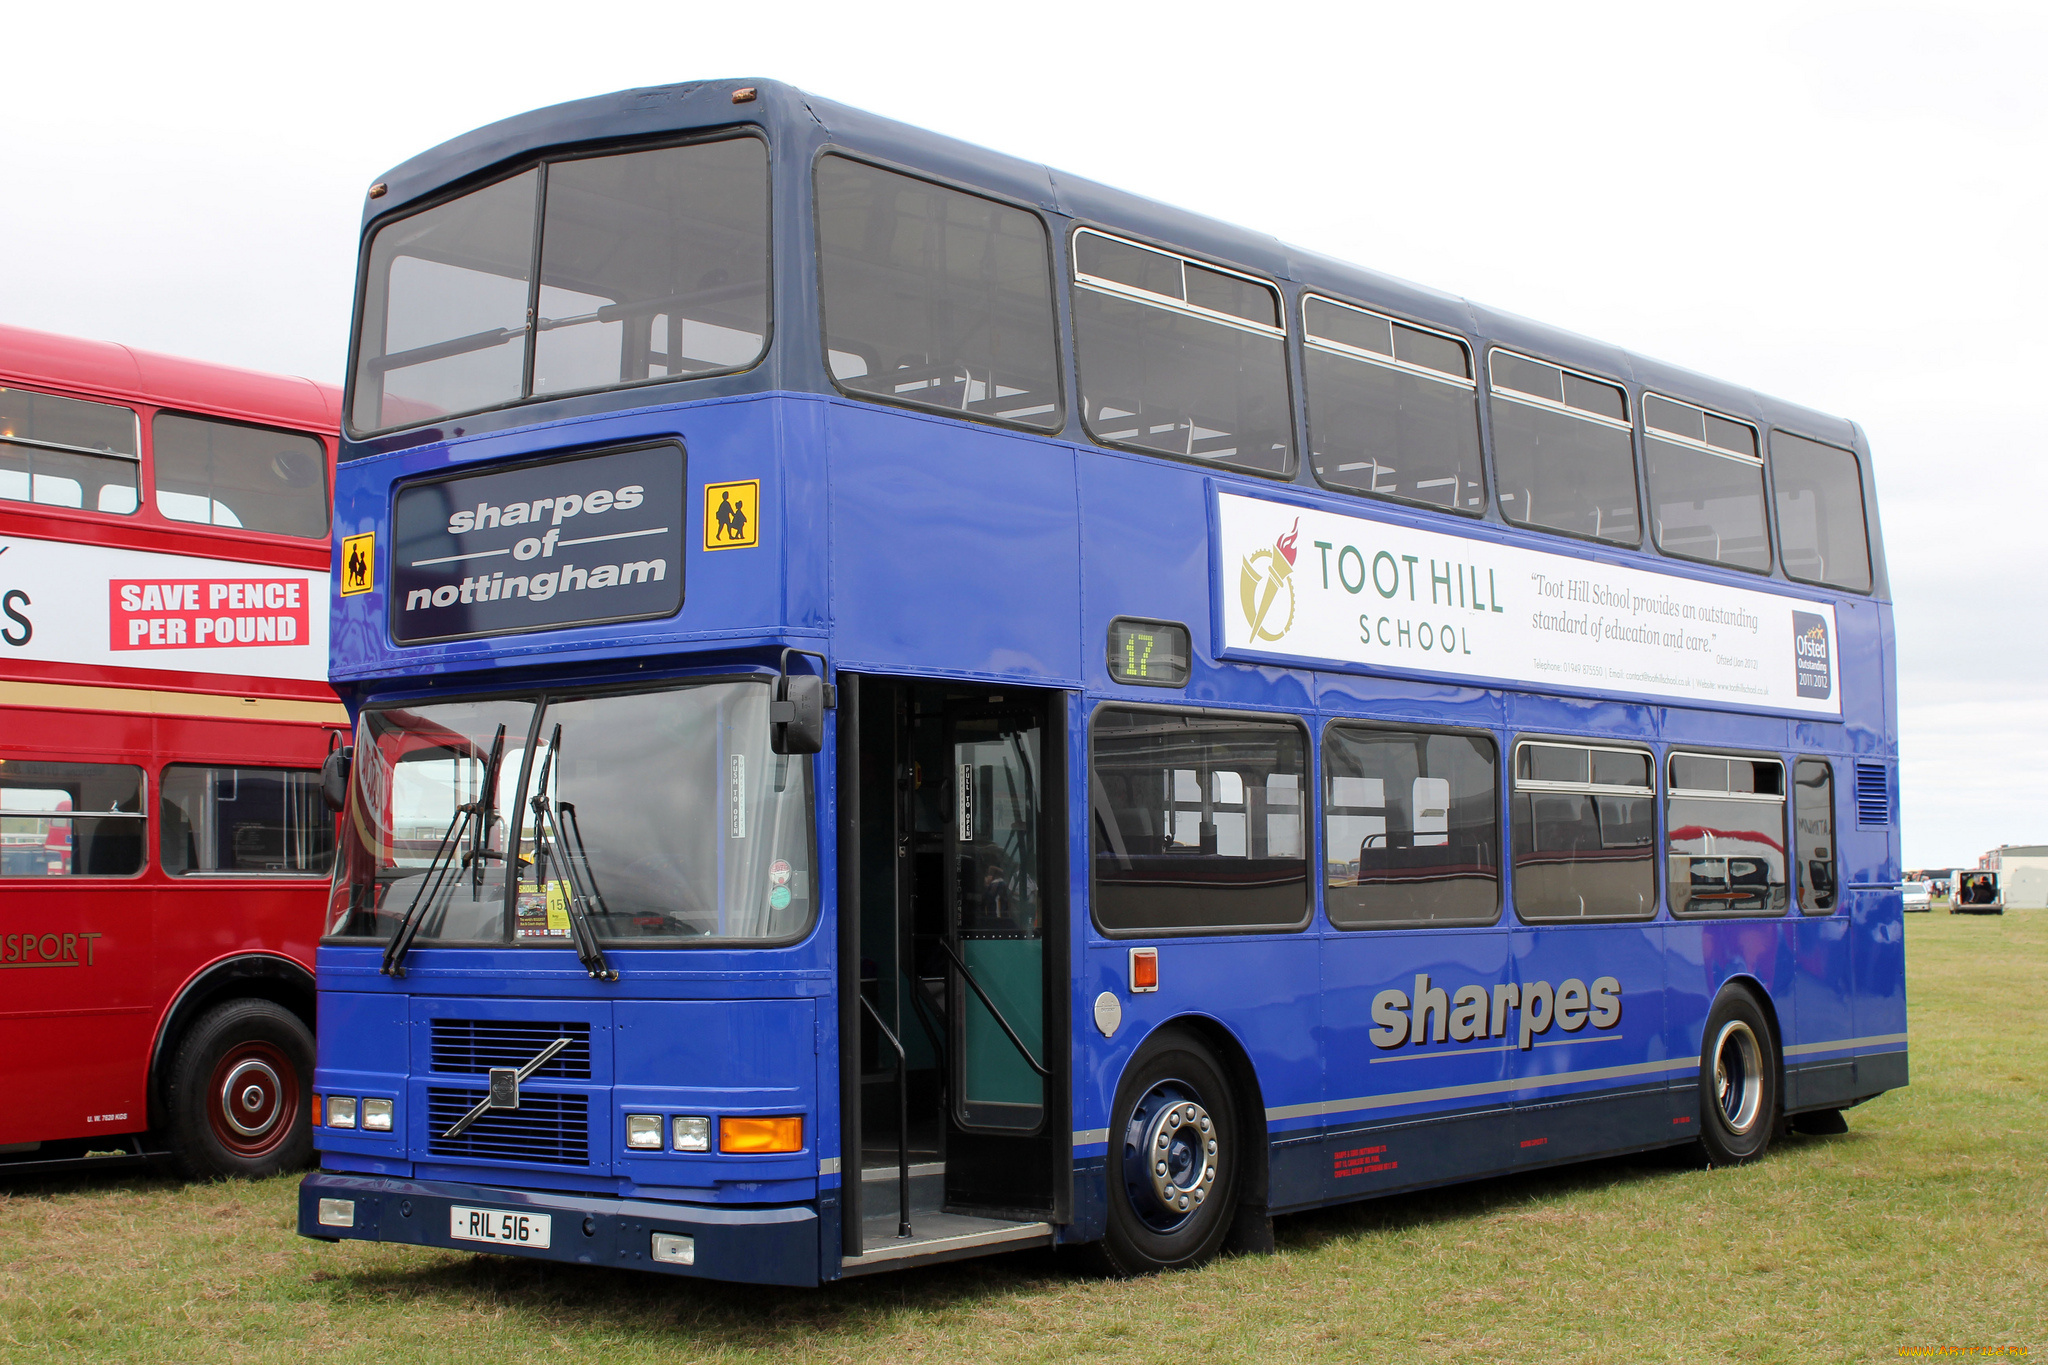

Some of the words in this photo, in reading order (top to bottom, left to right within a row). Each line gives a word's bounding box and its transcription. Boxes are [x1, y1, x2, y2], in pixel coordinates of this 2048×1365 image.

[447, 485, 645, 535] sharpes
[513, 528, 560, 561] of
[405, 558, 667, 612] nottingham
[1314, 540, 1419, 602] TOOT
[1430, 559, 1504, 613] HILL
[120, 584, 200, 612] SAVE
[209, 583, 301, 609] PENCE
[1531, 572, 1564, 599] “Toot
[1567, 579, 1590, 603] Hill
[1592, 584, 1630, 609] School
[1632, 594, 1680, 618] provides
[1682, 604, 1697, 620] an
[1698, 606, 1759, 635] outstanding
[128, 618, 187, 646] PER
[195, 616, 297, 644] POUND
[1359, 614, 1471, 655] SCHOOL
[1532, 610, 1588, 636] standard
[1590, 616, 1604, 643] of
[1605, 618, 1660, 646] education
[1663, 628, 1684, 649] and
[1685, 633, 1717, 653] care.”
[1126, 633, 1154, 677] 17
[1716, 654, 1733, 667] Ofsted
[1796, 634, 1827, 659] Ofsted
[1533, 658, 1563, 673] Telephone:
[1563, 662, 1582, 674] 01949
[1797, 657, 1828, 675] Outstanding
[1799, 672, 1813, 687] 2011
[1813, 674, 1829, 689] 2012
[733, 790, 738, 802] TO
[965, 796, 970, 808] TO
[1368, 973, 1624, 1051] sharpes
[469, 1211, 496, 1238] RIL
[501, 1215, 530, 1241] 516
